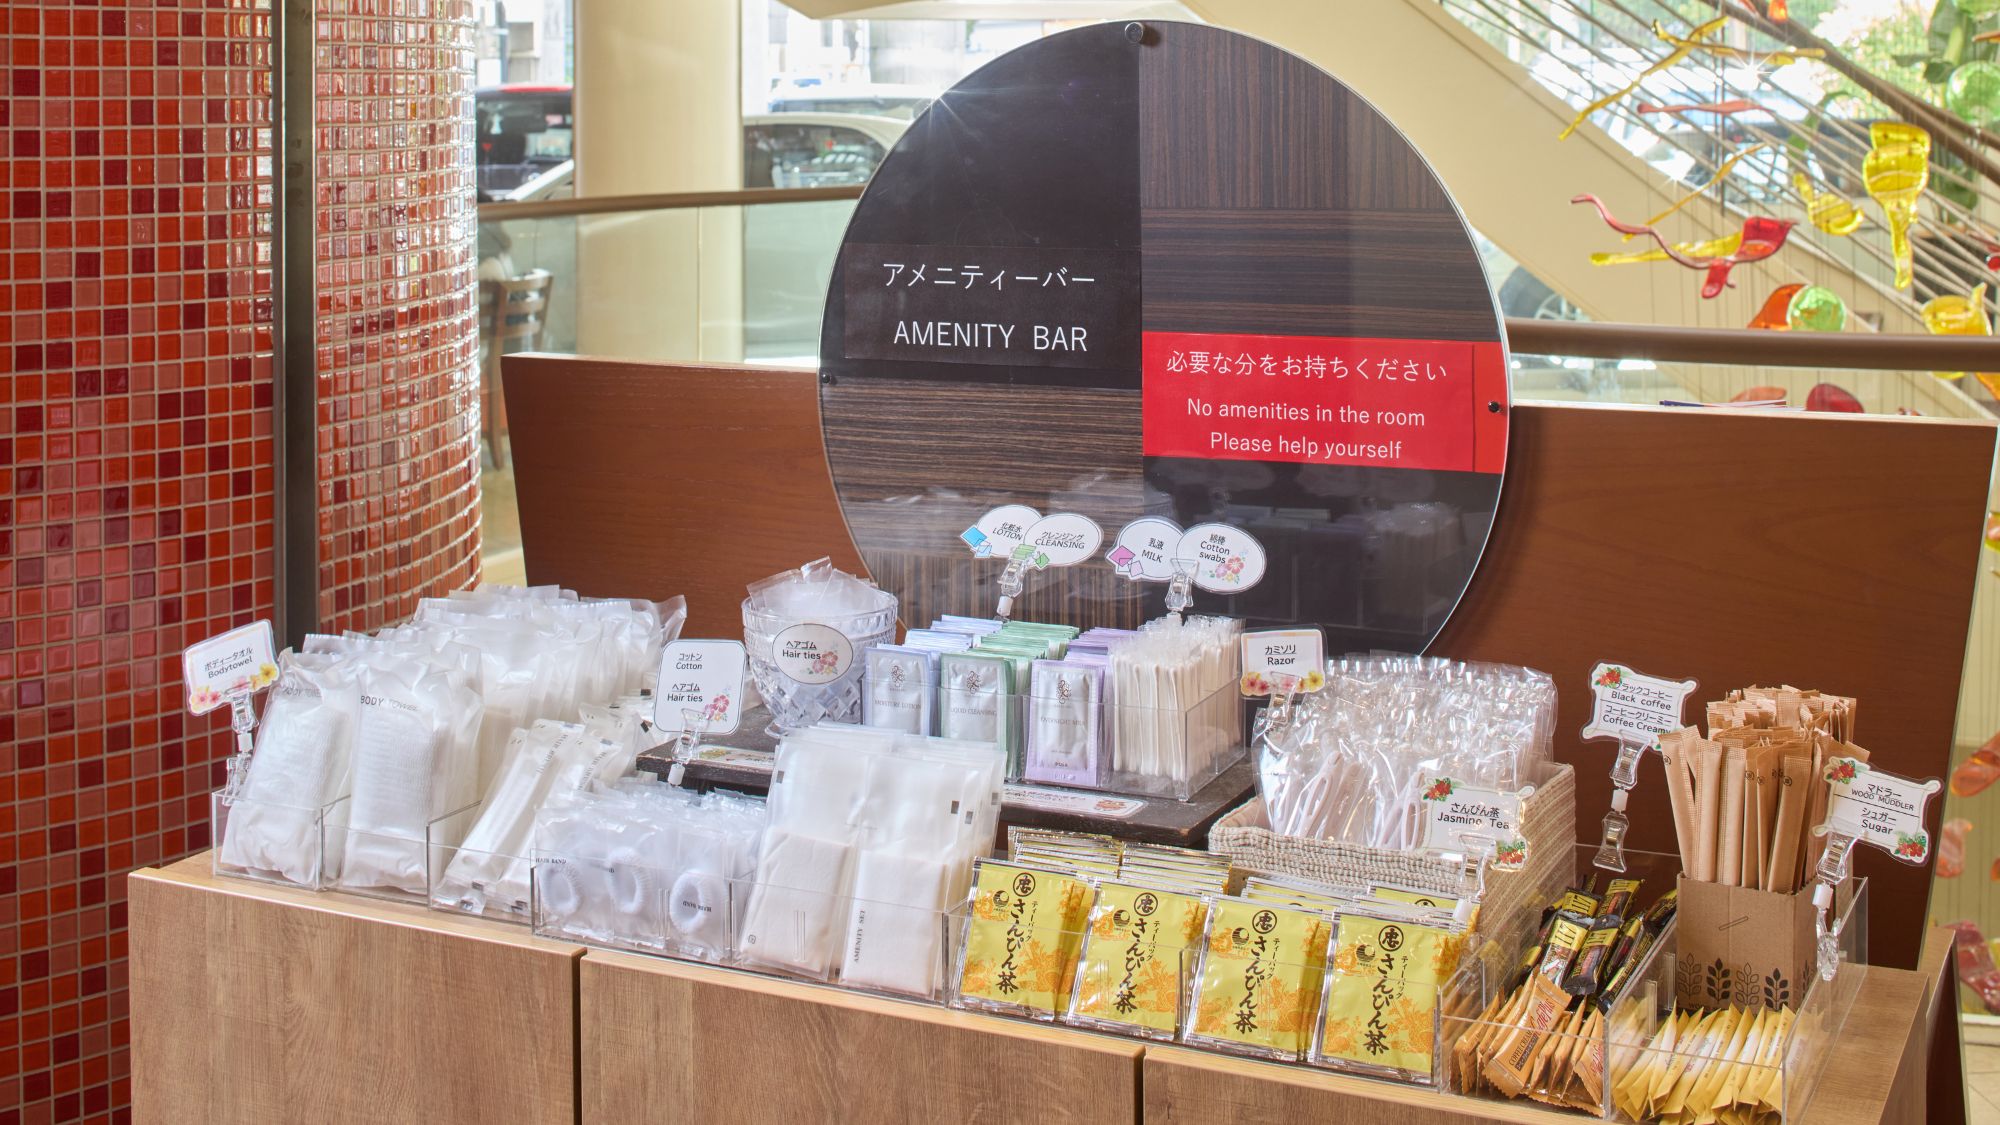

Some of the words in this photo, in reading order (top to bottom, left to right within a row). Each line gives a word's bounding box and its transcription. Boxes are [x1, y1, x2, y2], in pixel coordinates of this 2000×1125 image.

[883, 263, 1095, 291] アメニティーバー
[893, 320, 1015, 348] AMENITY
[1033, 325, 1087, 351] BAR
[1166, 350, 1447, 381] 必要な分をお持ちください
[1187, 398, 1212, 416] No
[1218, 401, 1309, 421] amenities
[1316, 404, 1332, 422] in
[1339, 404, 1370, 424] the
[1376, 409, 1425, 426] room
[1210, 431, 1272, 452] Please
[1279, 435, 1318, 457] help
[1324, 440, 1402, 459] yourself
[992, 527, 1023, 540] LOTION
[1041, 531, 1085, 542] クレンジング
[1034, 538, 1085, 549] CLEANSING
[1148, 537, 1164, 550] 乳液
[1200, 540, 1230, 555] Cotton
[1141, 549, 1163, 563] MILK
[1199, 551, 1226, 564] swabs
[786, 640, 817, 650] ヘアゴム
[1265, 644, 1297, 655] カミソリ
[204, 646, 253, 671] ボディータオル
[678, 652, 702, 661] コットン
[782, 649, 801, 659] Hair
[802, 650, 822, 660] ties
[1267, 656, 1296, 666] Razor
[208, 655, 253, 679] Bodytowel
[675, 661, 703, 670] Cotton
[671, 682, 700, 691] ヘアゴム
[360, 695, 384, 706] BODY
[667, 693, 684, 702] Hair
[686, 694, 703, 703] ties
[1611, 690, 1636, 703] Black
[1640, 698, 1672, 711] coffee
[1602, 714, 1634, 728] Coffee
[1604, 704, 1672, 726] コーヒークリーミー
[1867, 783, 1902, 798] マドラー
[1851, 788, 1875, 800] WOOD
[1877, 795, 1914, 811] MUDDLER
[1450, 802, 1500, 818] さんぴん茶
[1862, 807, 1897, 822] シュガー
[1437, 811, 1482, 826] Jasmine
[1489, 818, 1510, 830] Tea
[1861, 819, 1893, 835] Sugar
[1571, 894, 1592, 912] 117
[1554, 922, 1577, 945] 117
[853, 929, 864, 963] AMENITY
[995, 898, 1026, 995] さんぴん茶
[1113, 917, 1148, 1015] さんぴん茶
[1232, 935, 1267, 1035] さんぴん茶
[1362, 953, 1395, 1056] さんぴん茶
